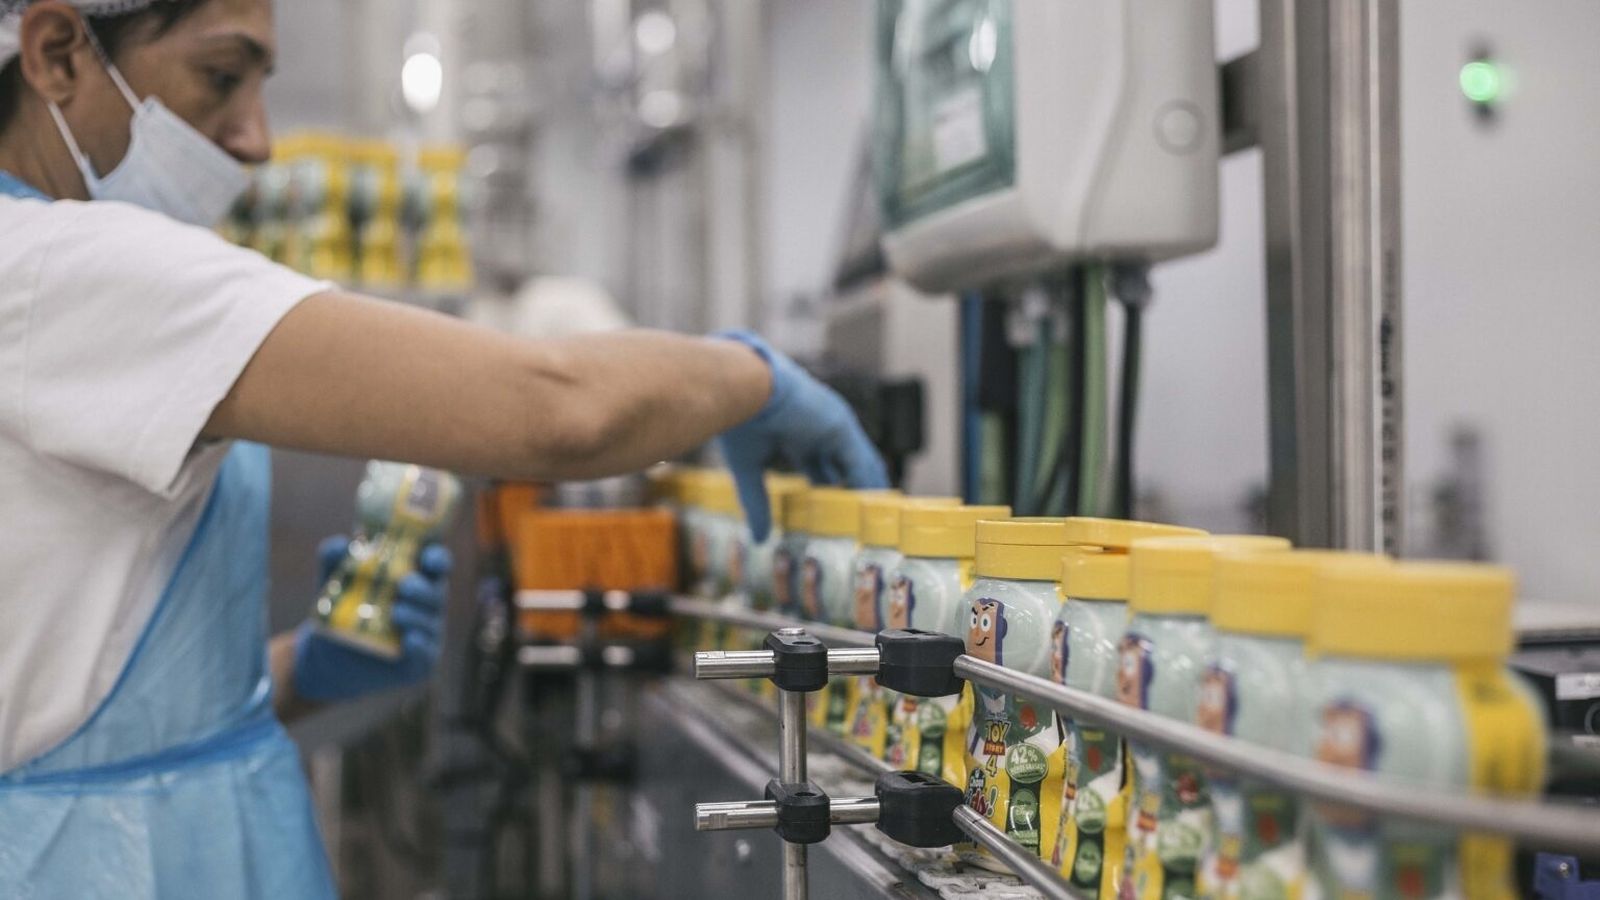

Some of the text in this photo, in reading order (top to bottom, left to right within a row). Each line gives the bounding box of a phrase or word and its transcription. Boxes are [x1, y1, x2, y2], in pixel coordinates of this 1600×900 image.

[985, 720, 1011, 743] TOY
[986, 754, 998, 777] 4
[1010, 746, 1039, 765] 42%
